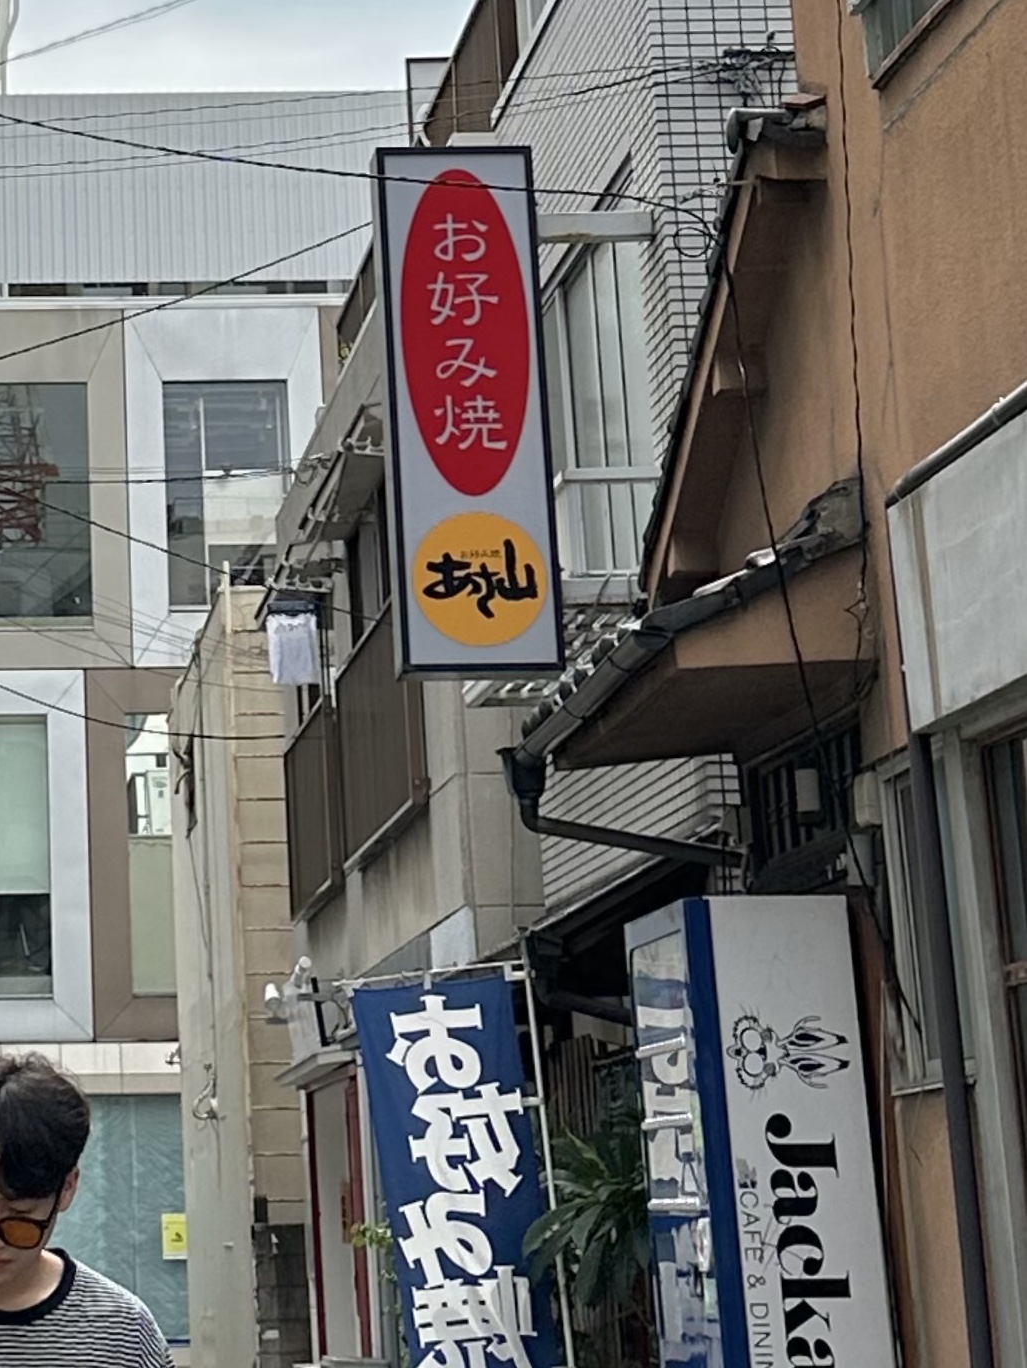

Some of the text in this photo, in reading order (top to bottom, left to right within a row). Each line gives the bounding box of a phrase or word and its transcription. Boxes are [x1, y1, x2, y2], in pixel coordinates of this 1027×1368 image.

[427, 212, 508, 451] お好み焼
[739, 1191, 764, 1262] CAFE
[747, 1274, 765, 1291] &
